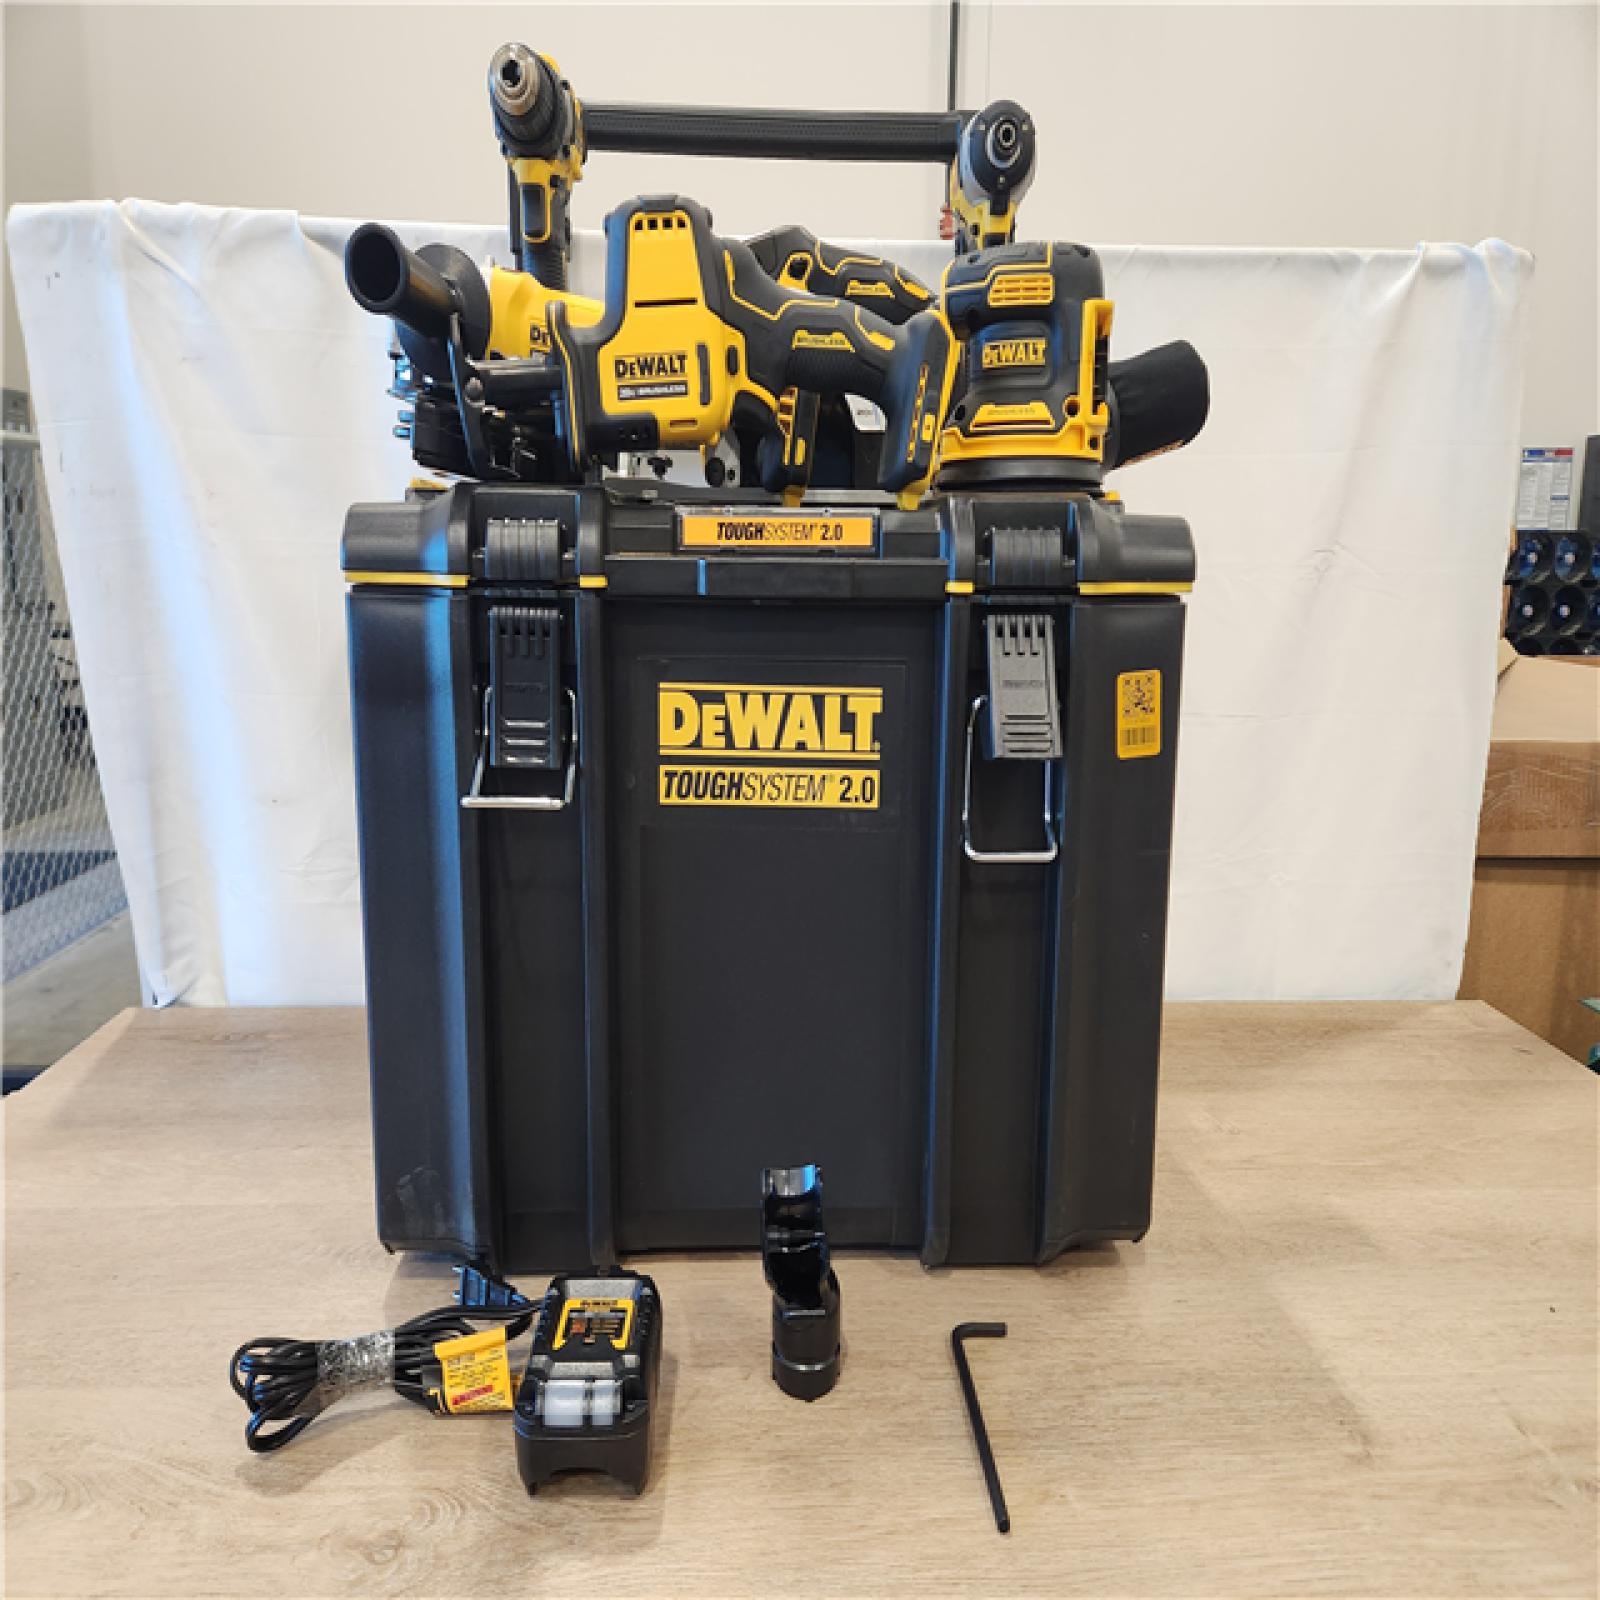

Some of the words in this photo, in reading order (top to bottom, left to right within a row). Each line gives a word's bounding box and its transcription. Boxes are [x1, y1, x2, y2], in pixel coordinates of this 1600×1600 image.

[614, 354, 688, 378] DEWALT
[717, 521, 814, 541] TOUGHSYSTEM
[819, 522, 844, 541] 2.0
[659, 690, 884, 752] DEWALT
[838, 774, 876, 804] 2.0
